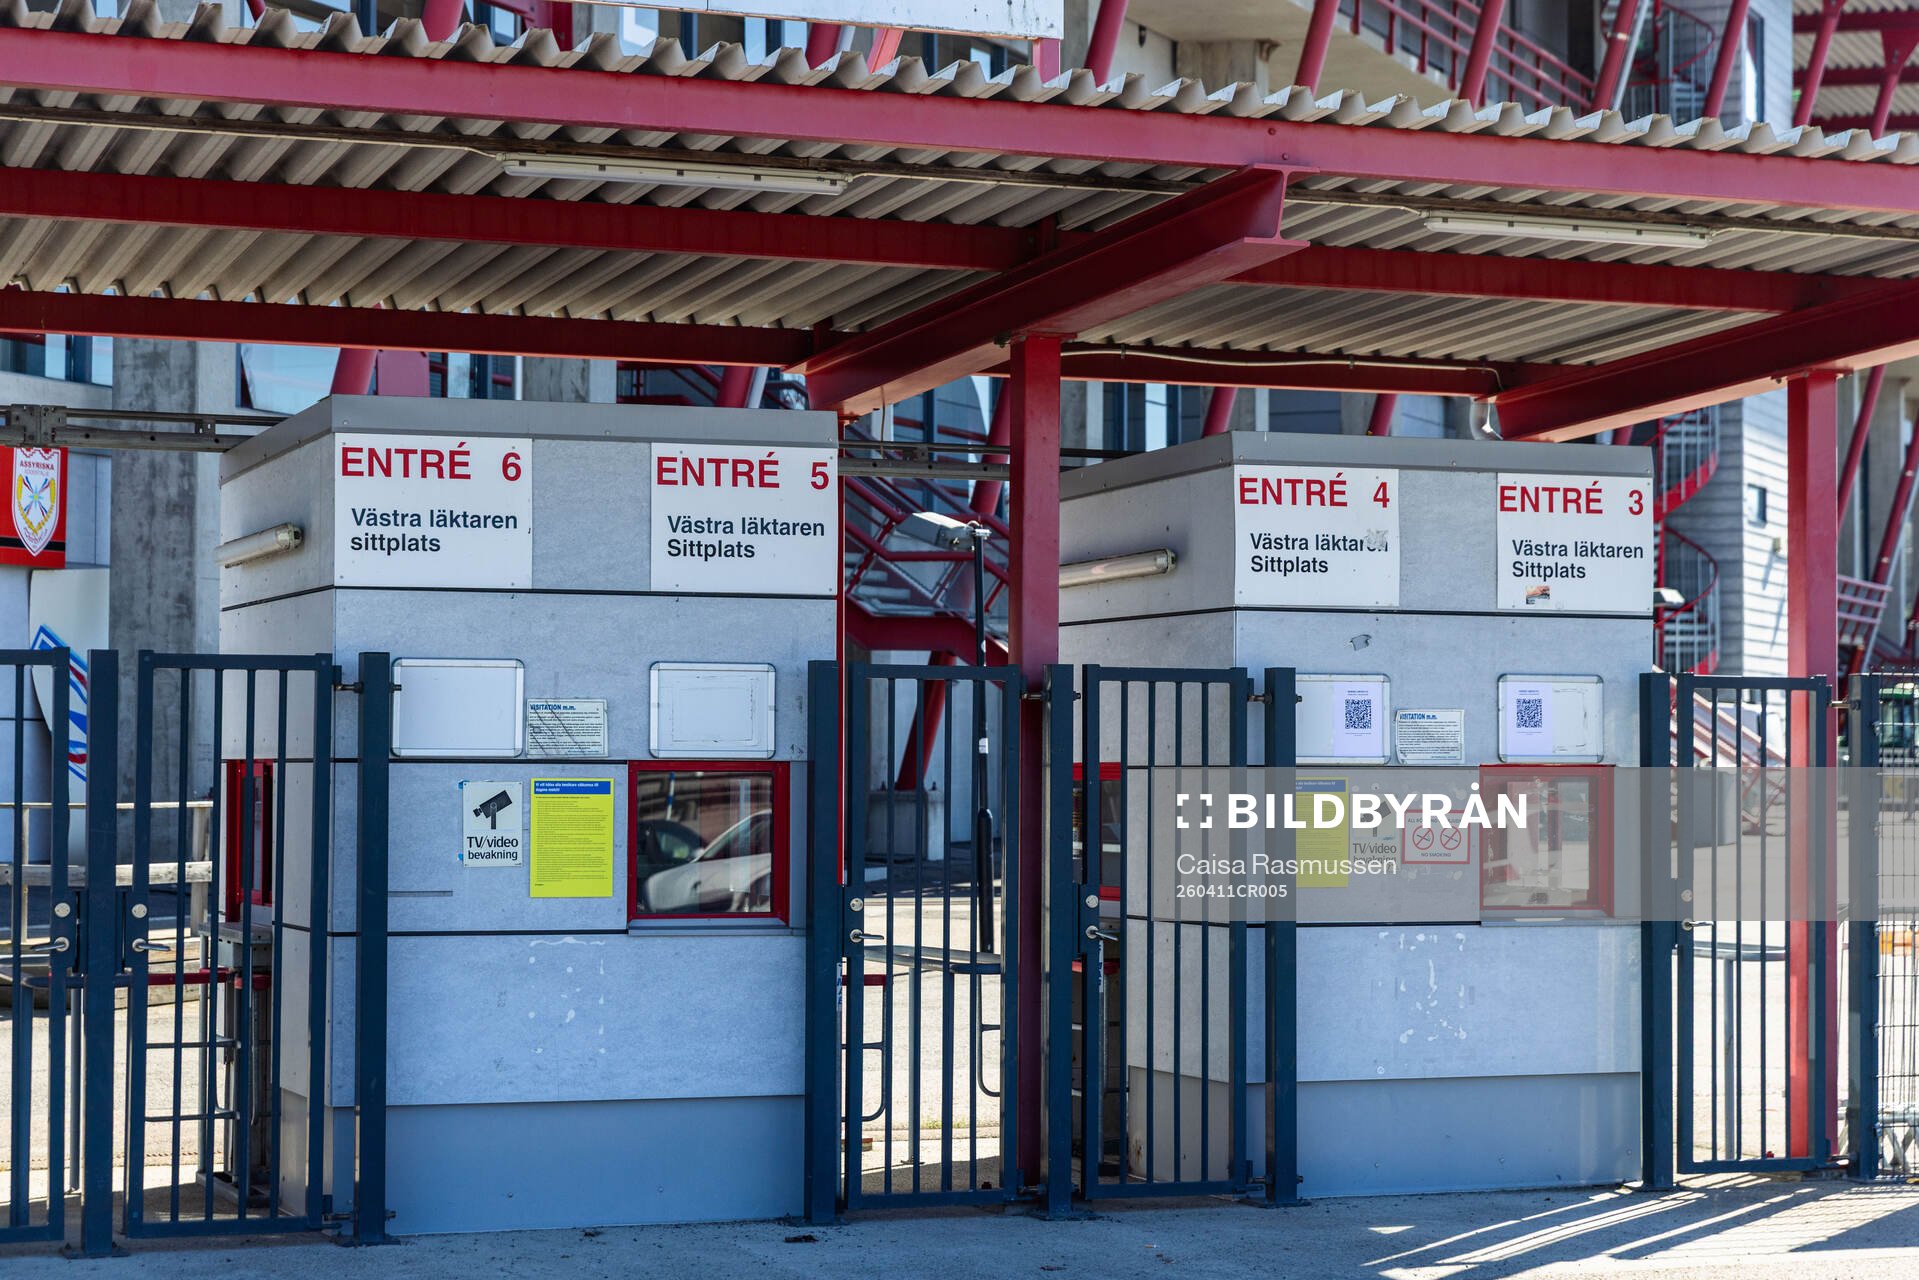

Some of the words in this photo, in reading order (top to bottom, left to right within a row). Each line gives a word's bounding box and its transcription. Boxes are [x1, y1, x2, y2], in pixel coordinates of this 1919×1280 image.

[341, 441, 471, 480] ENTRÉ
[501, 452, 522, 482] 6
[656, 451, 780, 489] ENTRÉ
[810, 461, 830, 490] 5
[1239, 472, 1348, 507] ENTRÉ
[1373, 481, 1390, 509] 4
[1499, 480, 1604, 515] ENTRÉ
[1628, 489, 1644, 516] 3
[351, 507, 422, 528] Västra
[429, 509, 518, 530] läktaren
[667, 515, 735, 535] Västra
[741, 517, 825, 537] läktaren
[350, 532, 441, 557] sittplats
[667, 538, 756, 562] Sittplats
[1250, 532, 1309, 551] Västra
[1315, 533, 1389, 552] läktar
[1512, 539, 1568, 558] Västra
[1574, 541, 1644, 559] läktaren
[1250, 555, 1329, 577] Sittplats
[1512, 560, 1587, 582] Sittplats
[466, 835, 519, 849] TV/video
[1352, 842, 1397, 855] TV/video
[468, 849, 518, 861] bevakning
